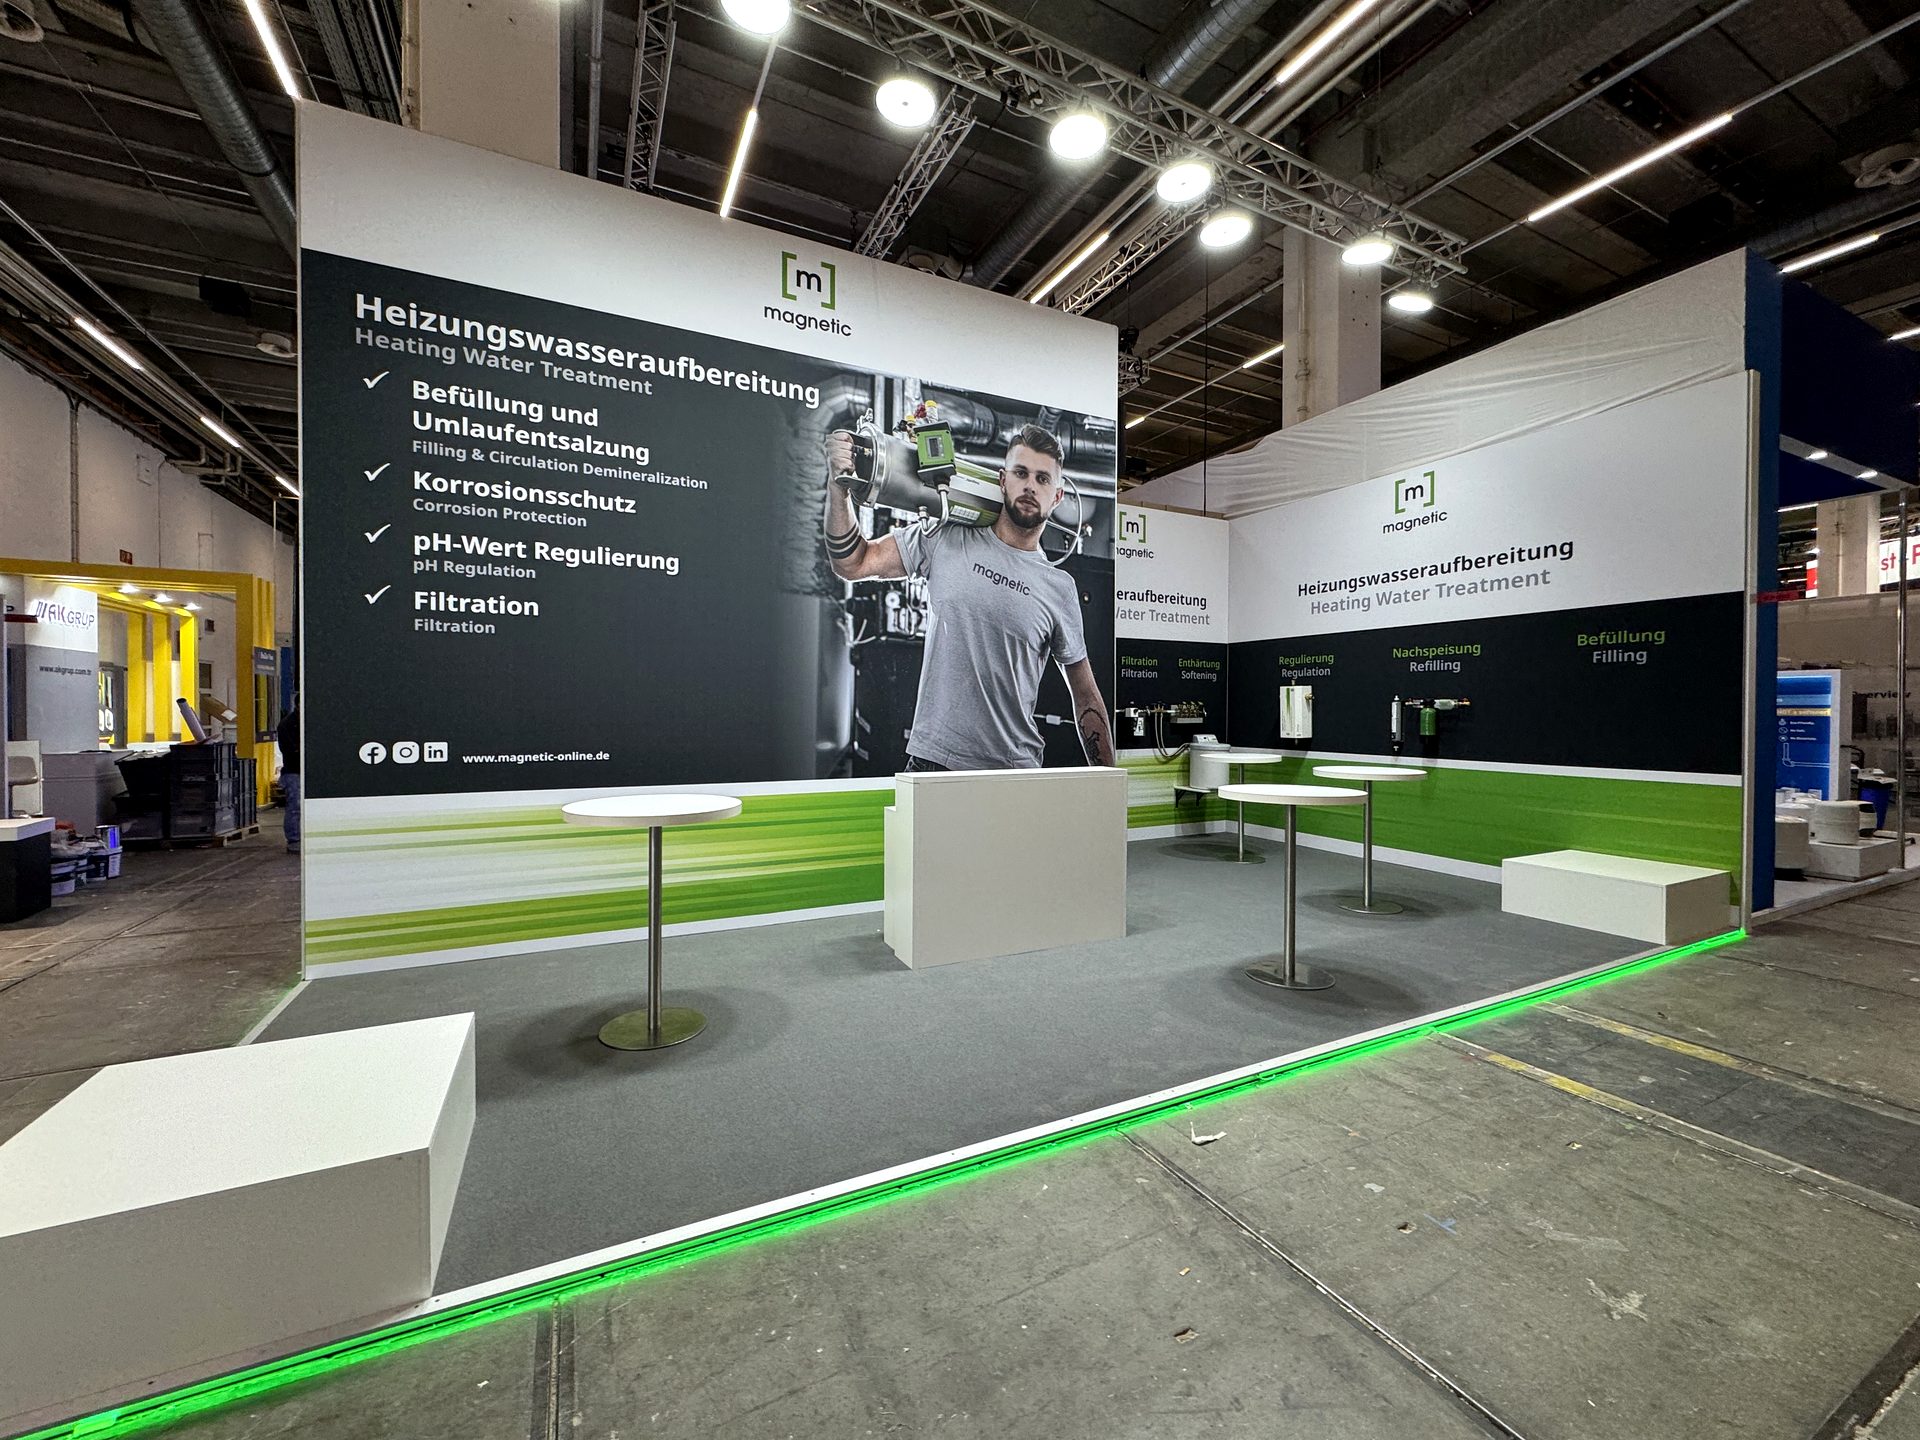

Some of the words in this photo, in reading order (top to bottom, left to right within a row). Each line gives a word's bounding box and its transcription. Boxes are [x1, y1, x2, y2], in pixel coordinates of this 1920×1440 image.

[764, 305, 852, 337] magnetic
[354, 326, 456, 365] Heating
[462, 345, 535, 375] Water
[541, 359, 653, 396] Treatment
[355, 293, 821, 409] Heizungswasseraufbereitung
[412, 379, 544, 423] Befüllung
[551, 405, 599, 428] und
[412, 409, 650, 465] Umlaufentsalzung
[412, 439, 467, 462] Filling
[472, 447, 485, 462] &
[489, 449, 578, 475] Circulation
[583, 462, 709, 490] Demineralization
[413, 470, 637, 515] Korrosionsschutz
[412, 497, 498, 519] Corrosion
[503, 506, 587, 527] Protection
[1382, 509, 1448, 535] magnetic
[413, 532, 527, 560] pH-Wert
[534, 541, 680, 576] Regulierung
[413, 558, 438, 575] pH
[443, 560, 537, 580] Regulation
[972, 561, 1031, 596] magnetic
[1298, 540, 1574, 597] Heizungswasseraufbereitung
[1116, 589, 1207, 611] eraufbereitung
[1310, 595, 1371, 615] Heating
[1376, 586, 1430, 607] Water
[1436, 568, 1551, 600] Treatment
[413, 590, 540, 617] Filtration
[48, 604, 65, 623] AK
[67, 610, 95, 627] GRUP
[413, 618, 496, 634] Filtration
[1149, 609, 1210, 626] Treatment
[1577, 629, 1666, 648] Befüllung
[1121, 656, 1158, 667] Filtration
[1279, 653, 1335, 668] Regulierung
[1392, 643, 1482, 661] Nachspeisung
[1592, 649, 1648, 665] Filling
[1121, 668, 1158, 680] Filtration
[1178, 658, 1221, 671] Enthärtung
[1181, 669, 1218, 682] Softening
[1281, 666, 1332, 680] Regulation
[1409, 658, 1462, 674] Refilling
[462, 750, 610, 763] www.magnetic-online.de
